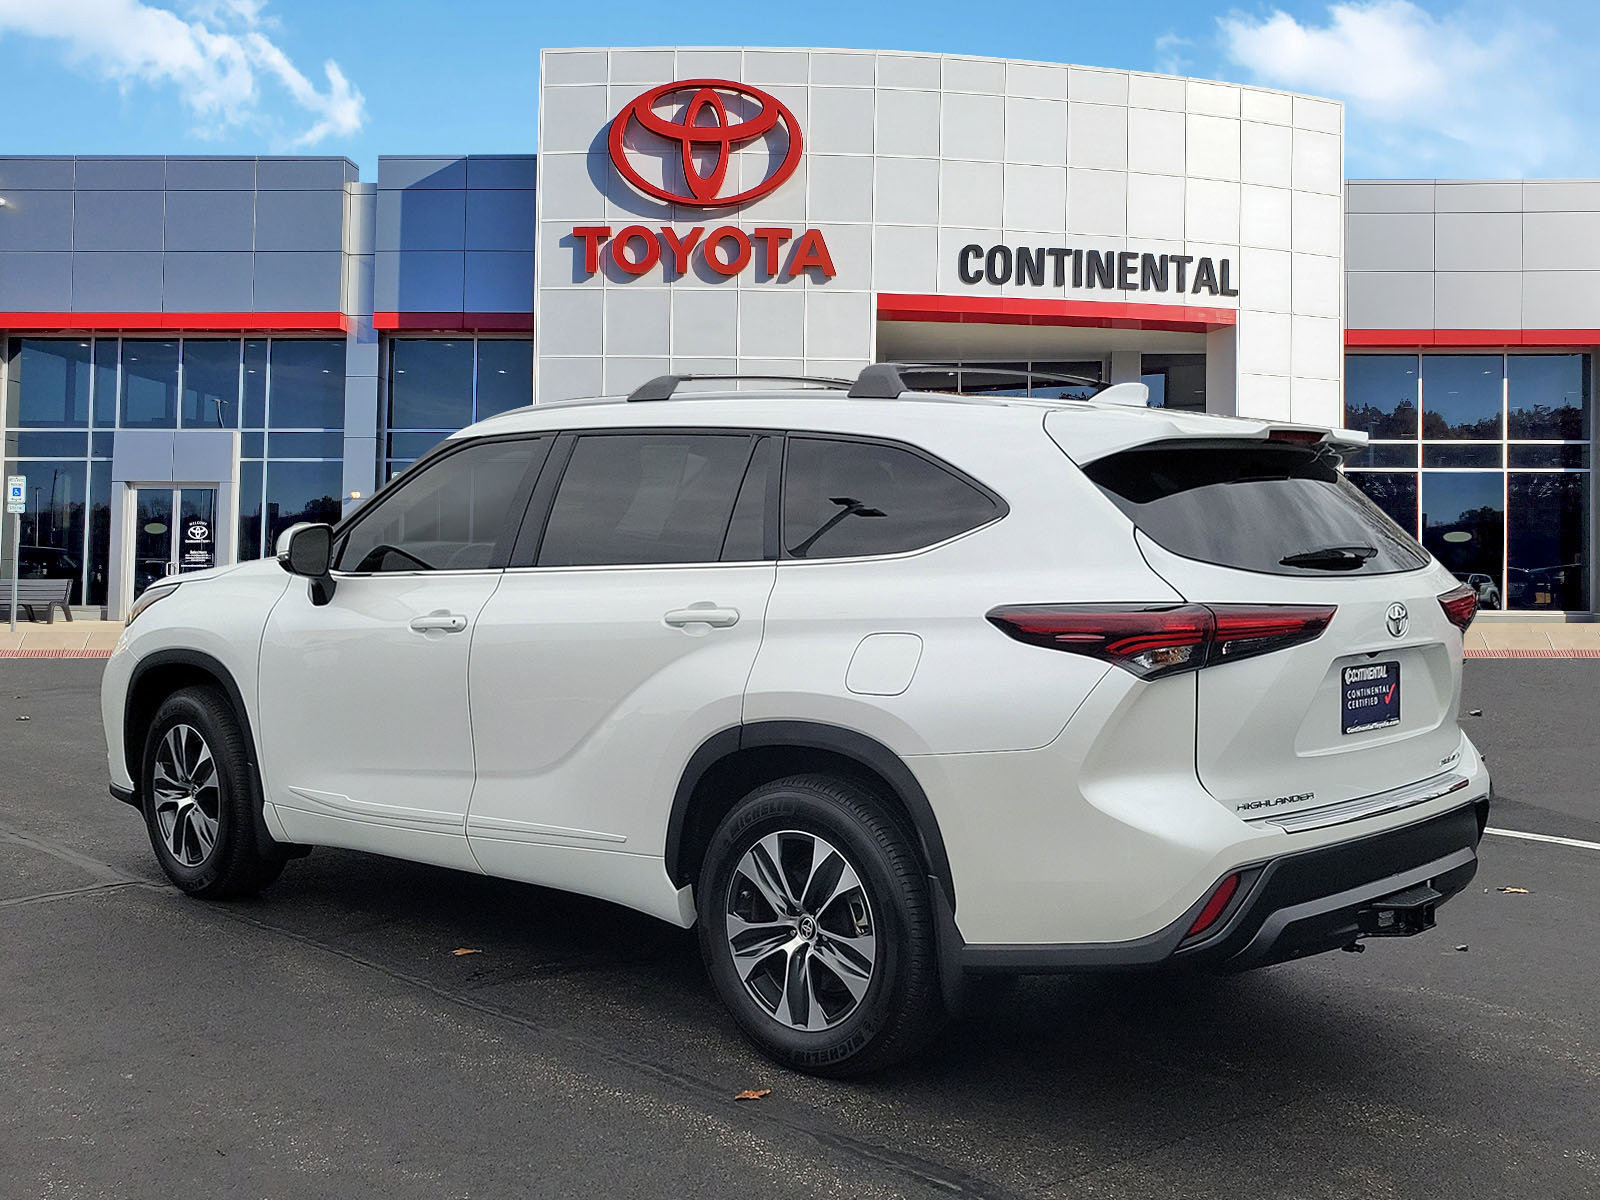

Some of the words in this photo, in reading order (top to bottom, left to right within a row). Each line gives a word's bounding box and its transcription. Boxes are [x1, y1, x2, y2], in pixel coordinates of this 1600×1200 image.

[573, 225, 836, 277] TOYOTA
[959, 244, 1239, 296] CONTINENTAL
[1347, 685, 1389, 699] CONTINENTAL
[1347, 697, 1378, 709] CERTIFIED
[1236, 792, 1315, 811] HIGHLANDER
